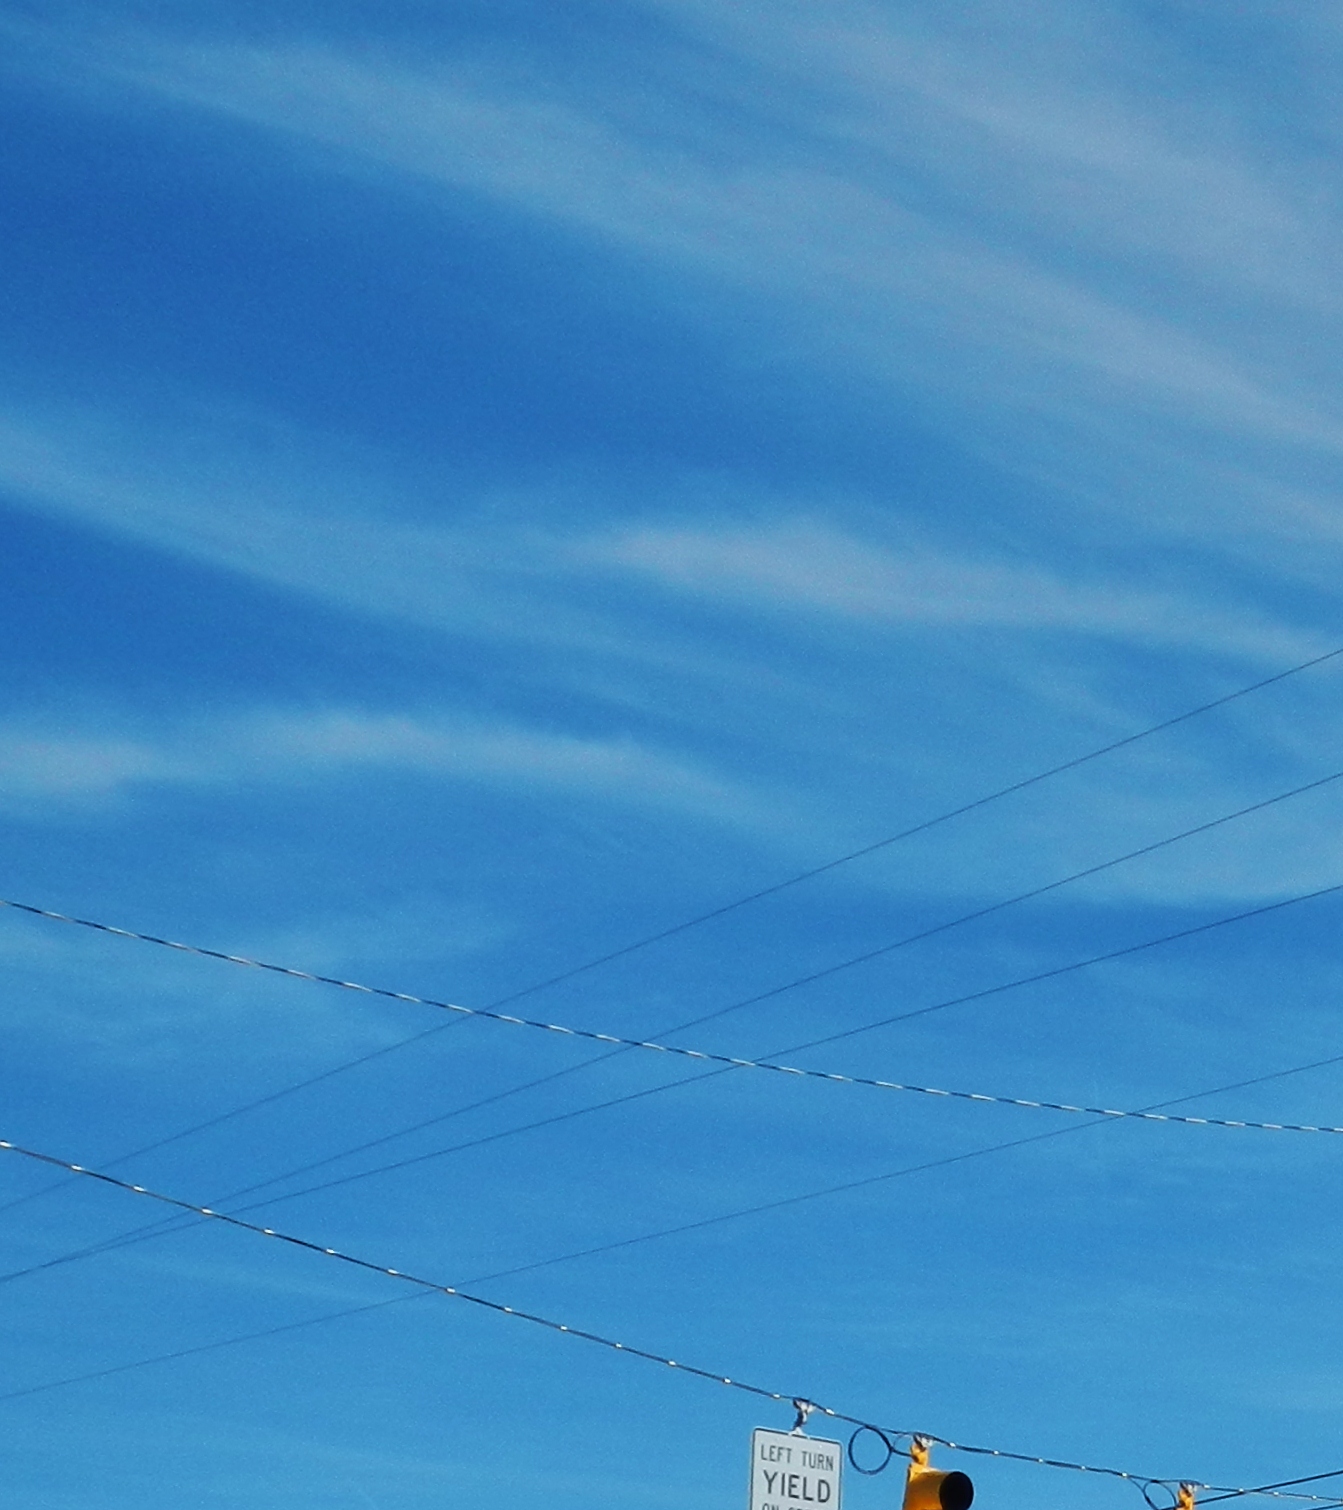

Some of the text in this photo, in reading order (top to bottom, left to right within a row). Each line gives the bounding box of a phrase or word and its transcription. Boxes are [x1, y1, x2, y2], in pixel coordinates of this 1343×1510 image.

[761, 1443, 834, 1472] LEFT TURN
[763, 1469, 831, 1503] YIELD
